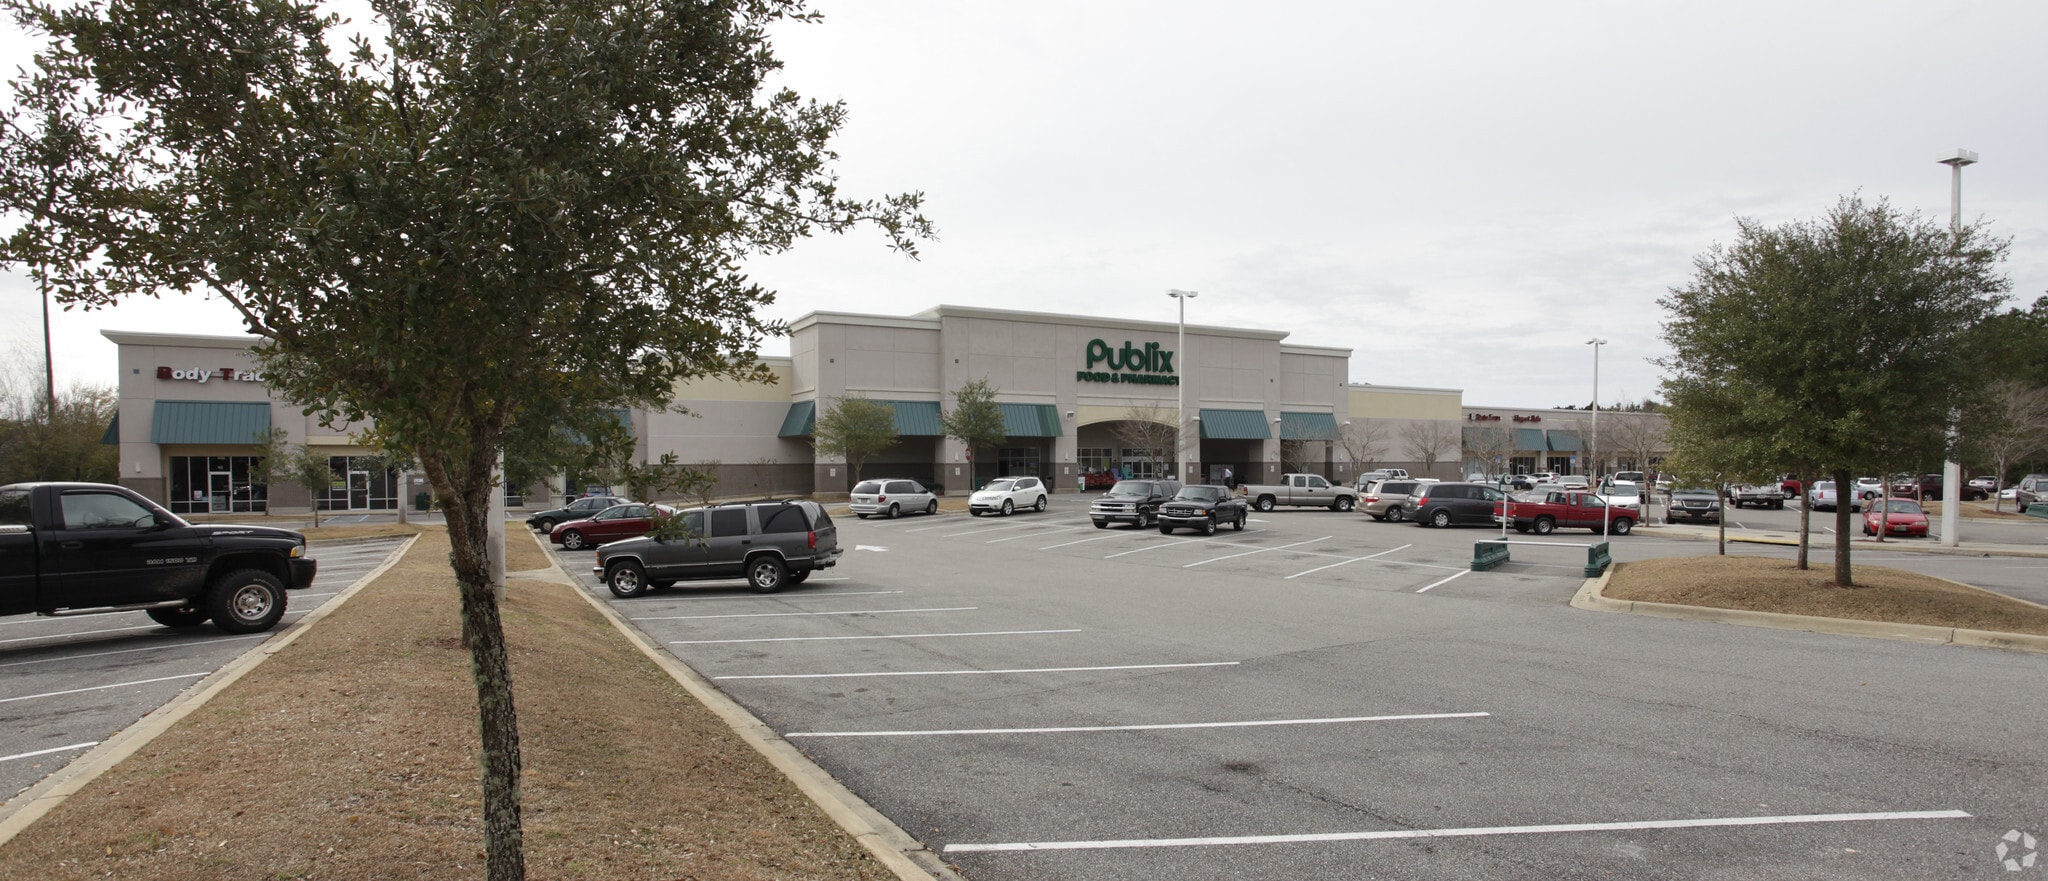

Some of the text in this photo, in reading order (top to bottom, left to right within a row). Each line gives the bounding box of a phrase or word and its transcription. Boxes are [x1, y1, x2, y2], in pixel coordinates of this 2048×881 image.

[1087, 338, 1174, 373] Publix
[156, 366, 212, 384] Body
[1077, 371, 1111, 383] FOOD
[1111, 372, 1120, 383] &
